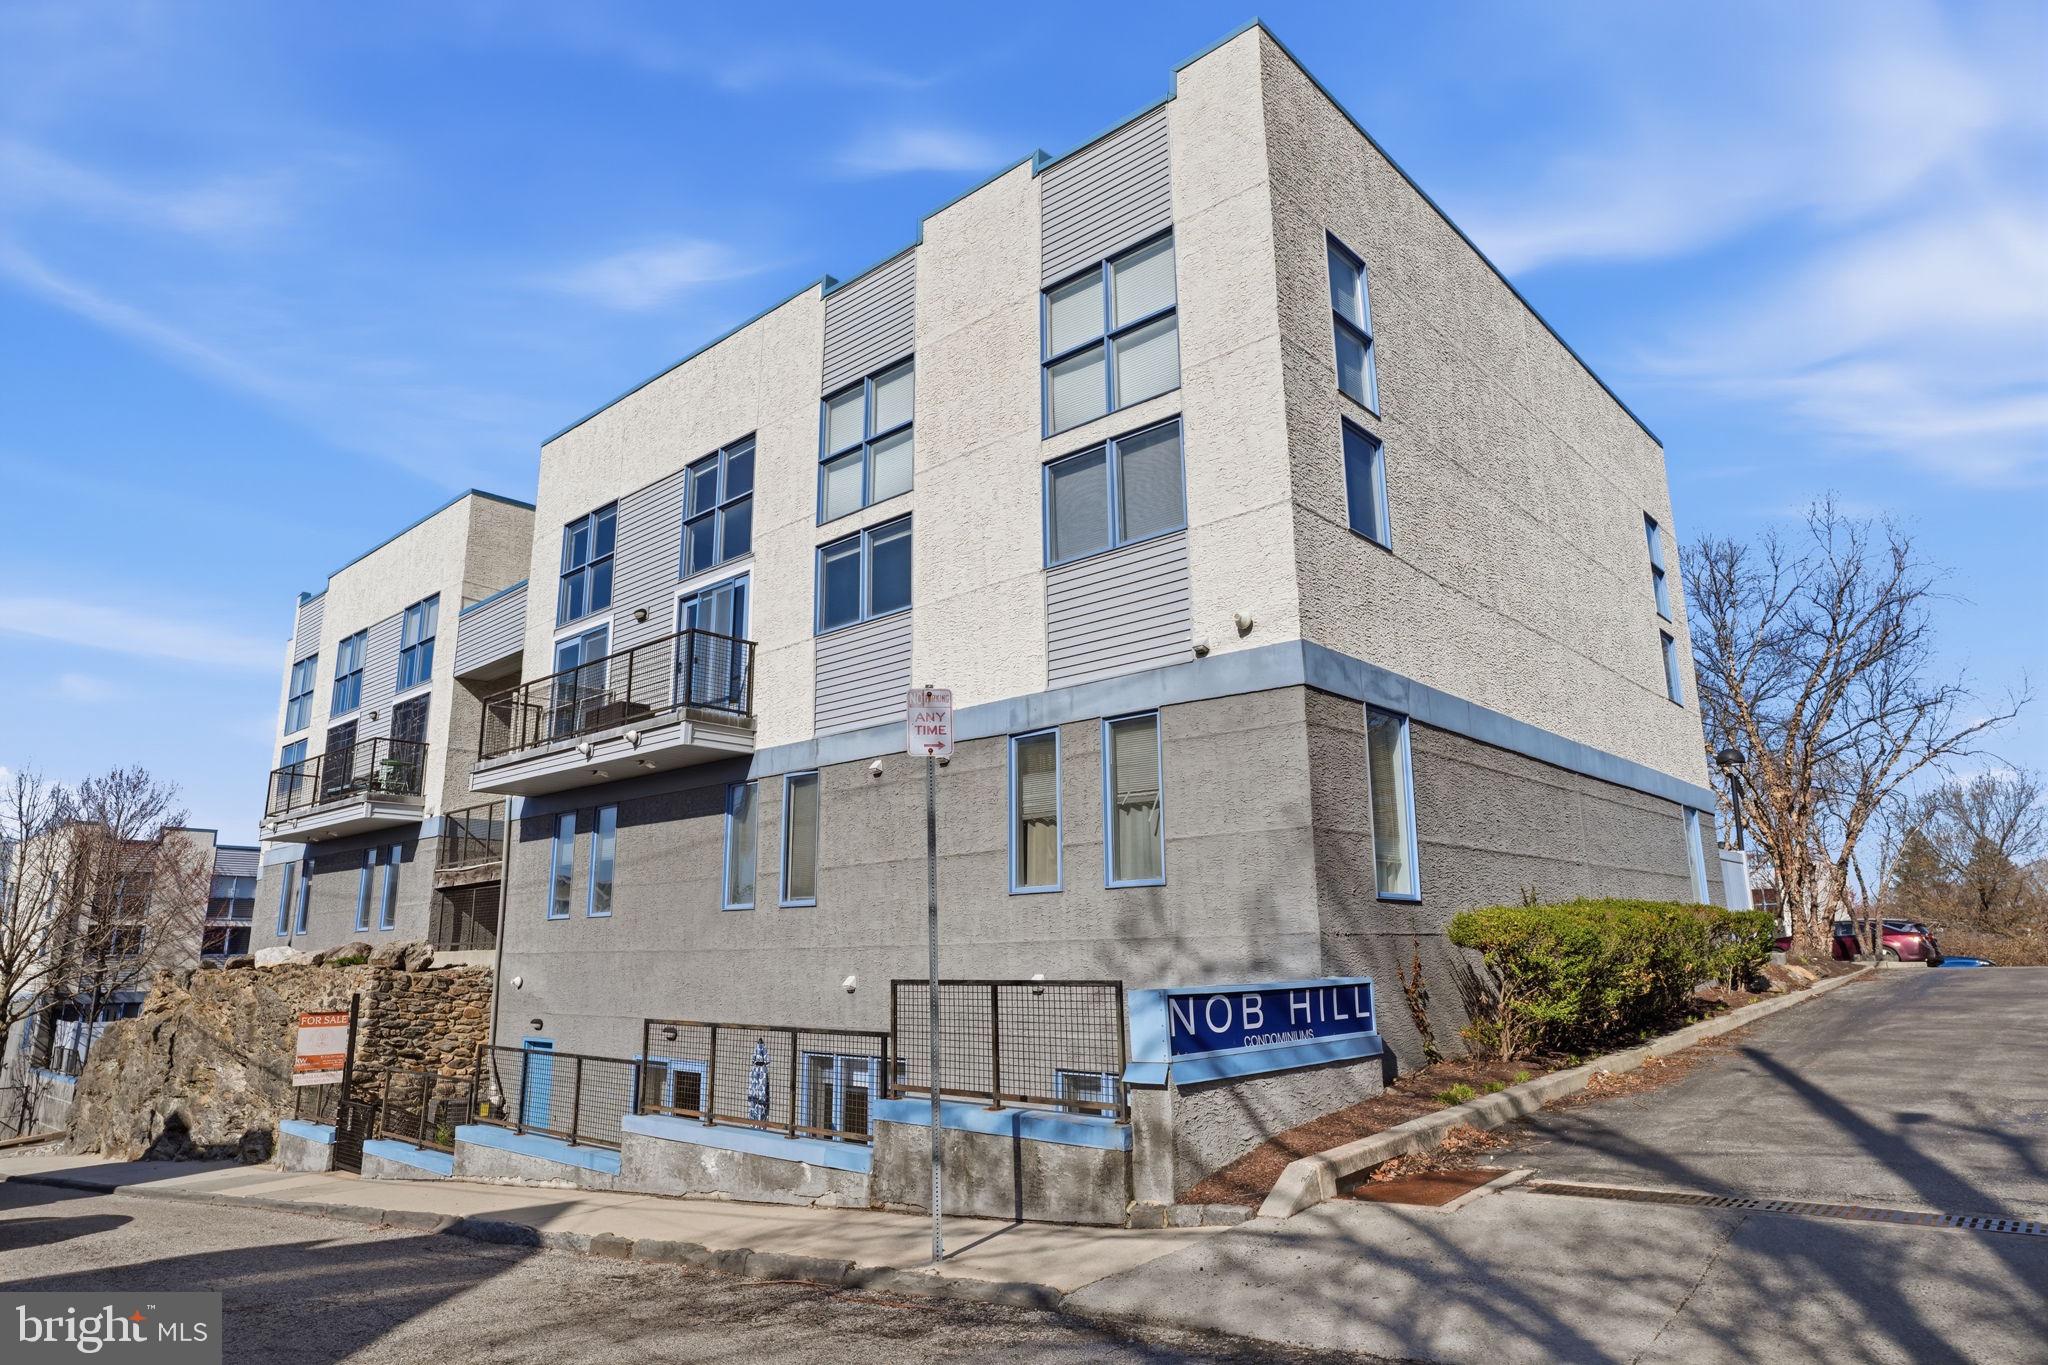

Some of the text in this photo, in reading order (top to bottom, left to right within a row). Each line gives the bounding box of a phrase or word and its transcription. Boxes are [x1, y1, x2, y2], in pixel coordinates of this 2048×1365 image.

[909, 692, 950, 704] NO PRKING
[915, 712, 946, 722] ANY
[914, 725, 947, 735] TIME
[1169, 986, 1370, 1037] NOB HILL
[301, 1015, 348, 1025] FOR SALE
[1243, 1028, 1315, 1047] CONDOMINIUMS
